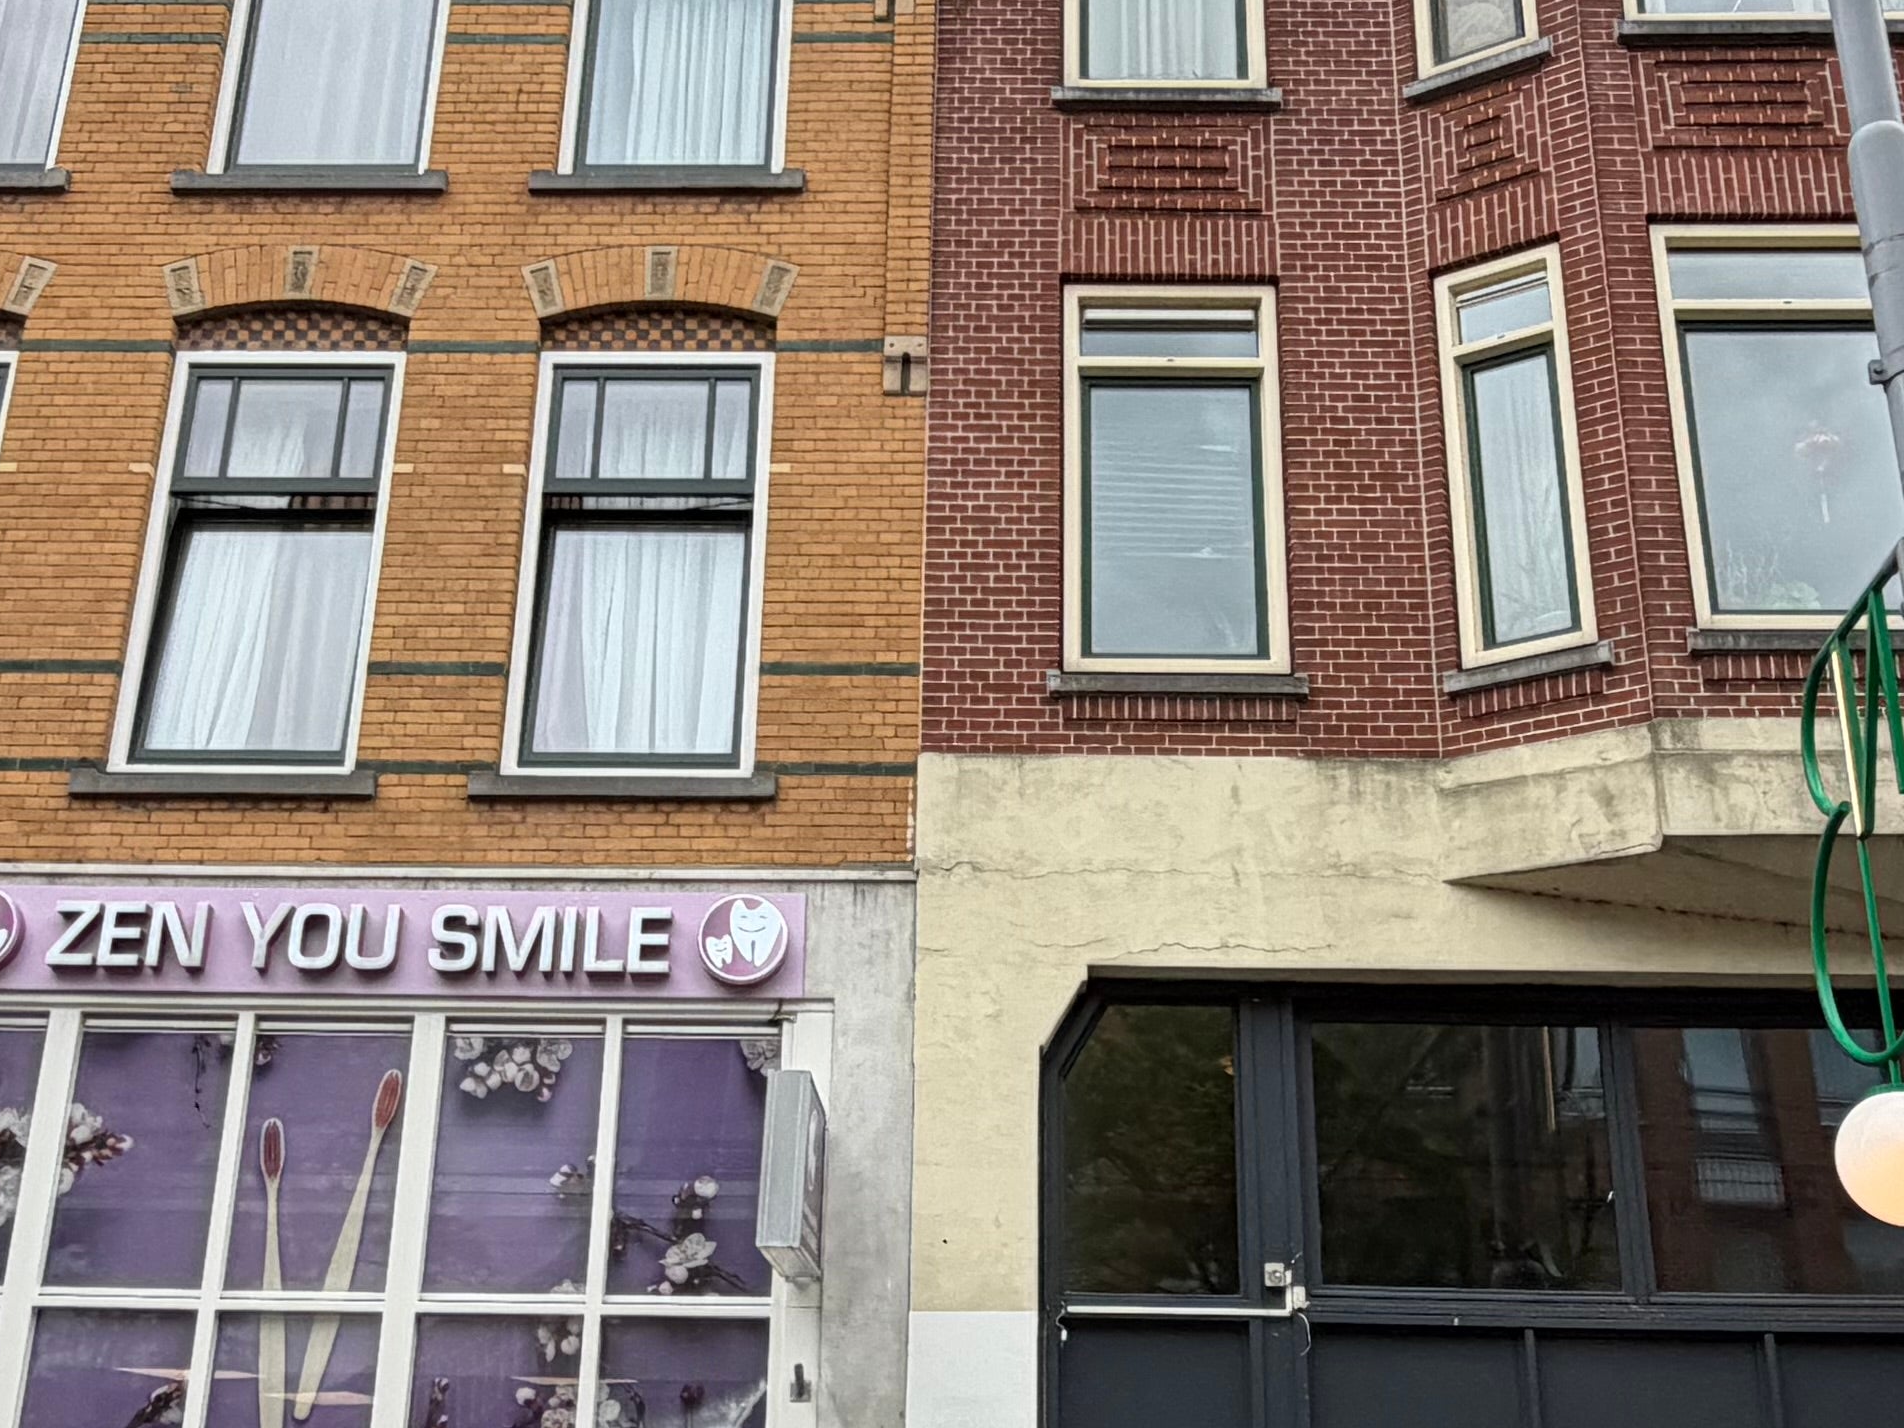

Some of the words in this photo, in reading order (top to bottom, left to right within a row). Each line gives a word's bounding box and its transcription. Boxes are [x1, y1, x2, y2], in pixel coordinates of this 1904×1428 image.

[45, 899, 213, 968] ZEN
[241, 902, 402, 972] YOU
[427, 904, 675, 974] SMILE
